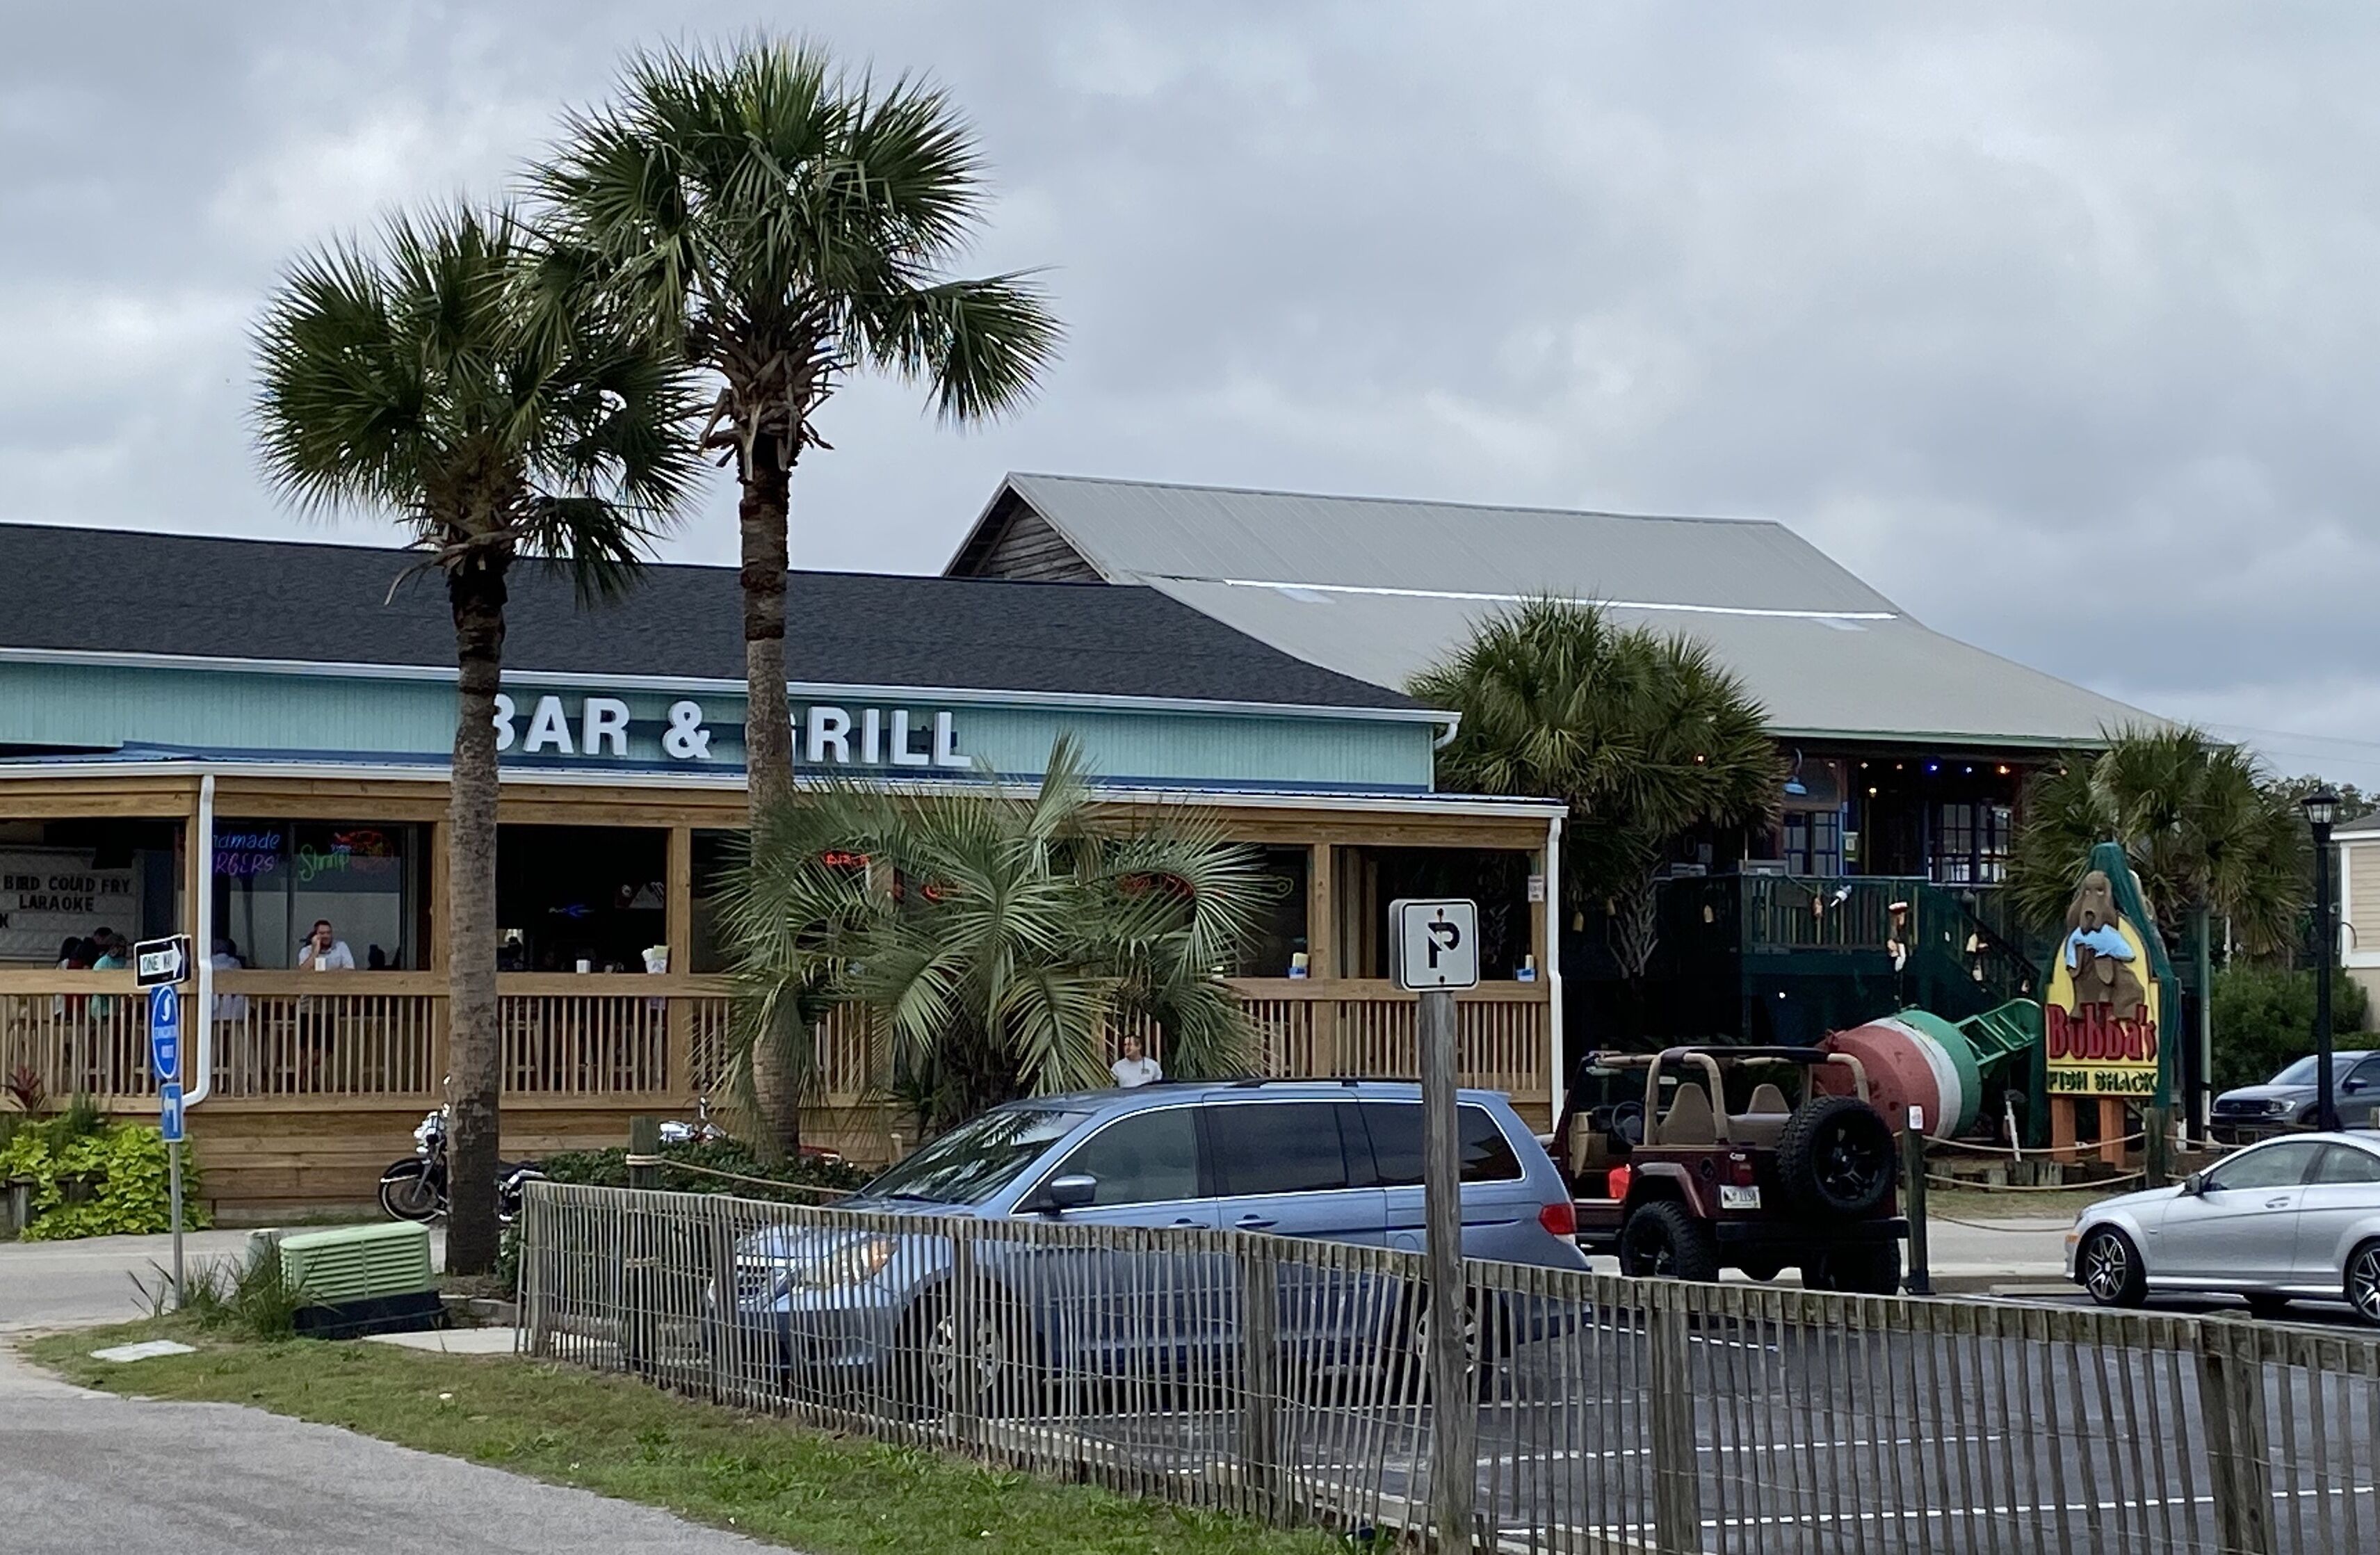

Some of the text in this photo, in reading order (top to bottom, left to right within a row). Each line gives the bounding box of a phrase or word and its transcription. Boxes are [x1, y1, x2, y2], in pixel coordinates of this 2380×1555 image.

[661, 700, 713, 759] &
[745, 705, 972, 767] RILL
[212, 852, 275, 876] RGERS
[143, 955, 159, 972] ONE
[2046, 1001, 2157, 1062] Bubba's
[2048, 1070, 2158, 1092] FISH SHACK
